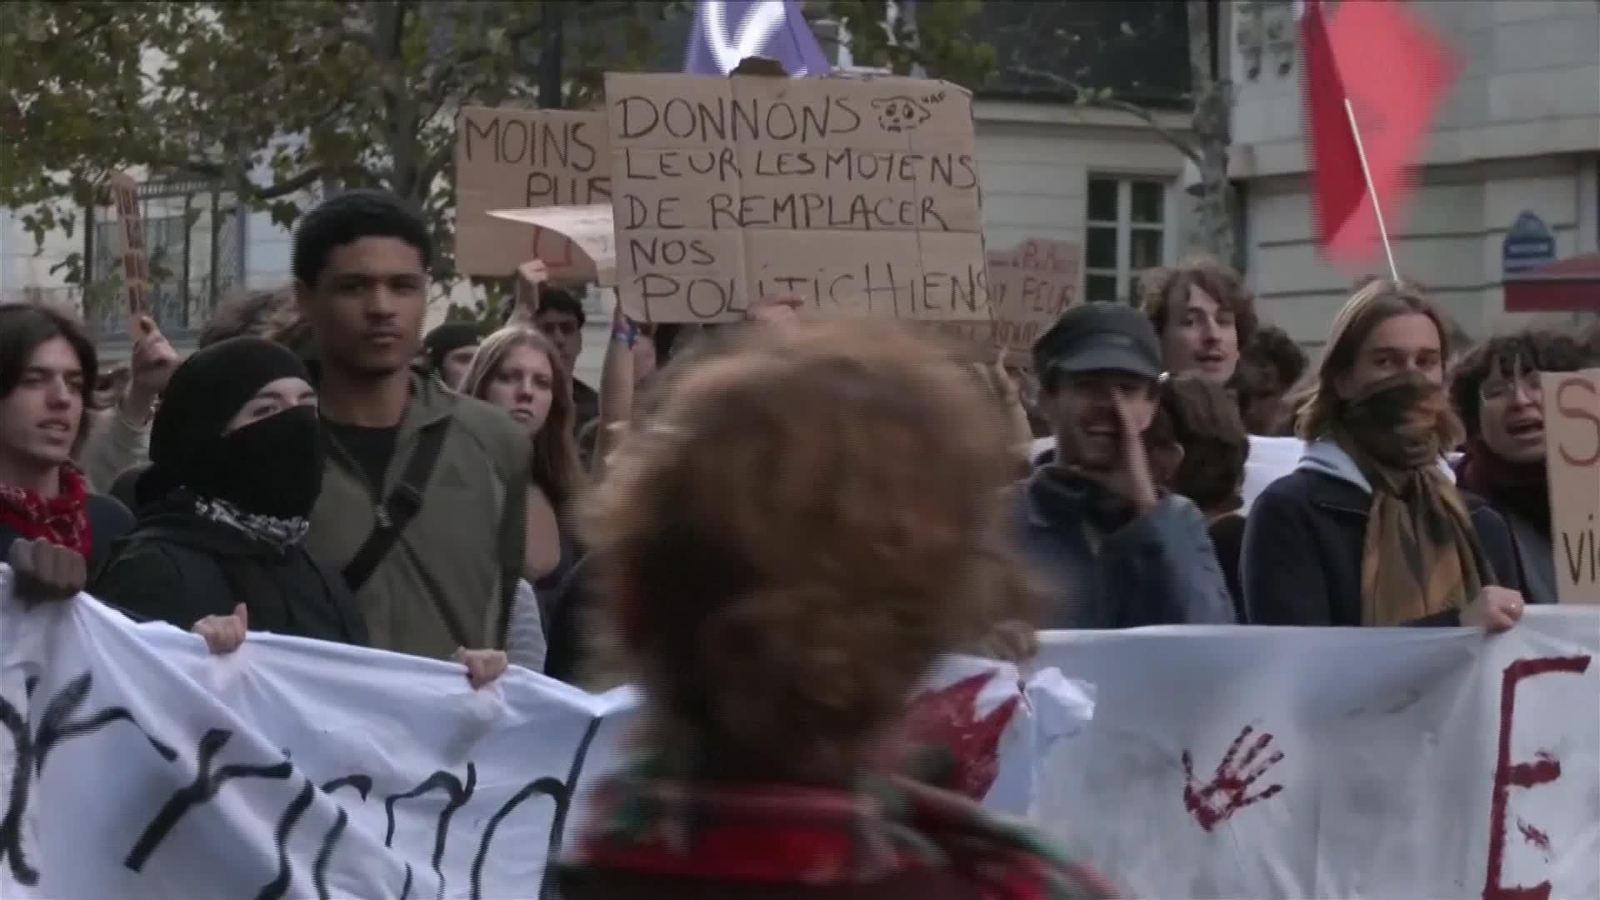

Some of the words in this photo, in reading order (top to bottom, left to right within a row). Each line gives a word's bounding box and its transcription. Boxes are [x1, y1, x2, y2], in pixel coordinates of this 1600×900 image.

[465, 116, 596, 173] MOINS
[625, 148, 743, 181] LEUR
[755, 150, 816, 176] LES
[825, 148, 976, 189] MOYENS
[625, 194, 686, 230] DE
[707, 193, 949, 232] REMPLACER
[629, 239, 715, 272] NOS
